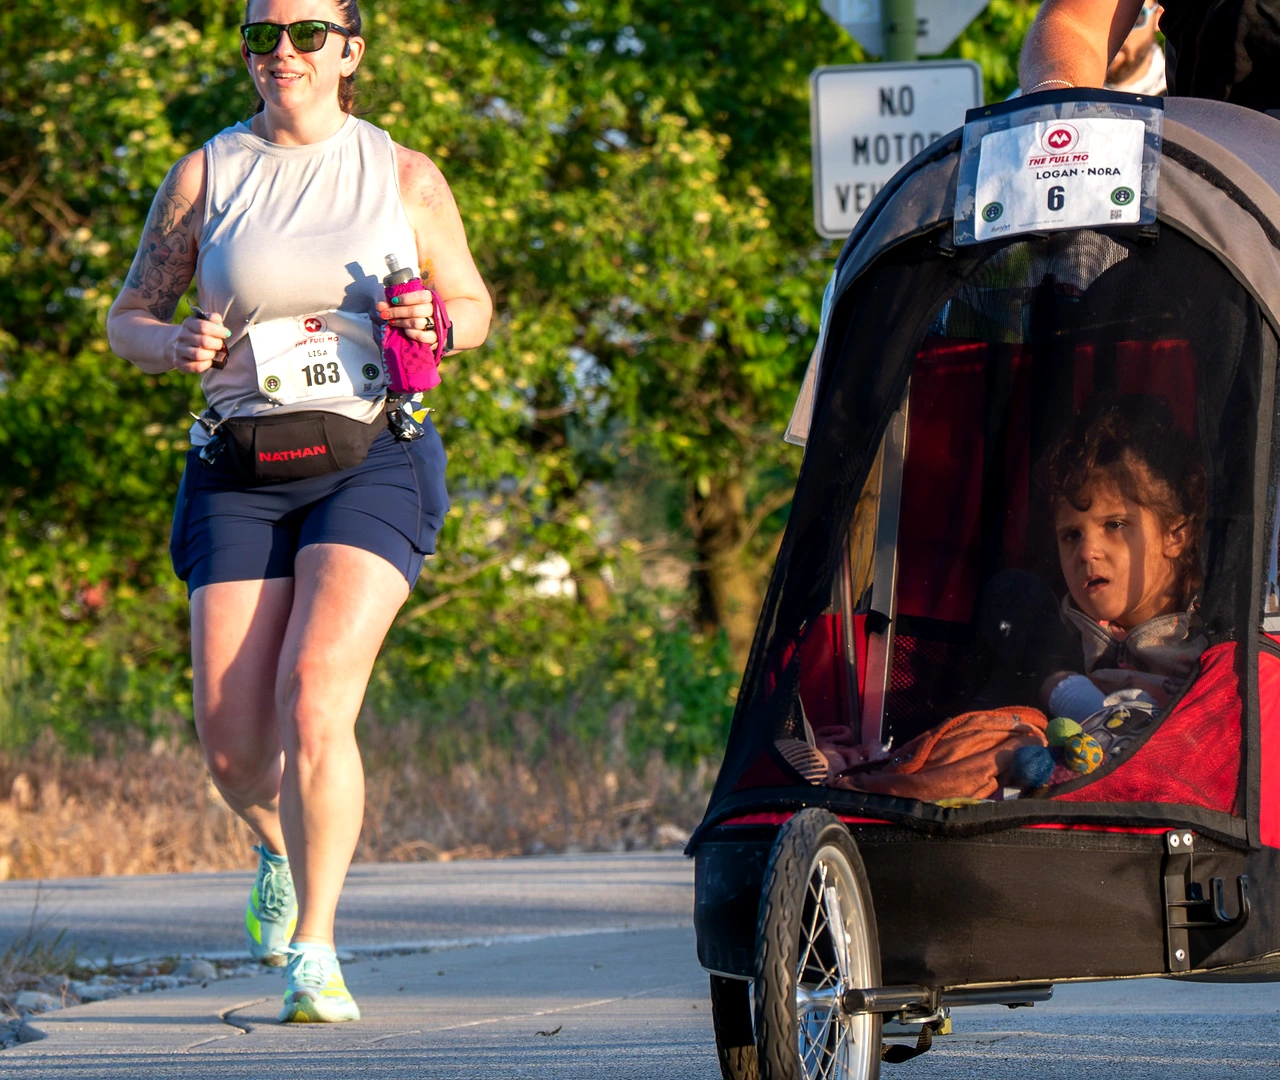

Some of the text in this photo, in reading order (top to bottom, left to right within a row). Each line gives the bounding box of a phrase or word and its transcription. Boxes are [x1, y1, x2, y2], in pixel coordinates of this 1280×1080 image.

[878, 85, 914, 117] NO
[1028, 153, 1089, 166] THE FULL MO
[1036, 167, 1121, 180] LOGAN NORA
[1047, 185, 1065, 211] 6
[308, 350, 328, 358] LISA
[301, 362, 340, 386] 183
[259, 444, 326, 463] NATHAN
